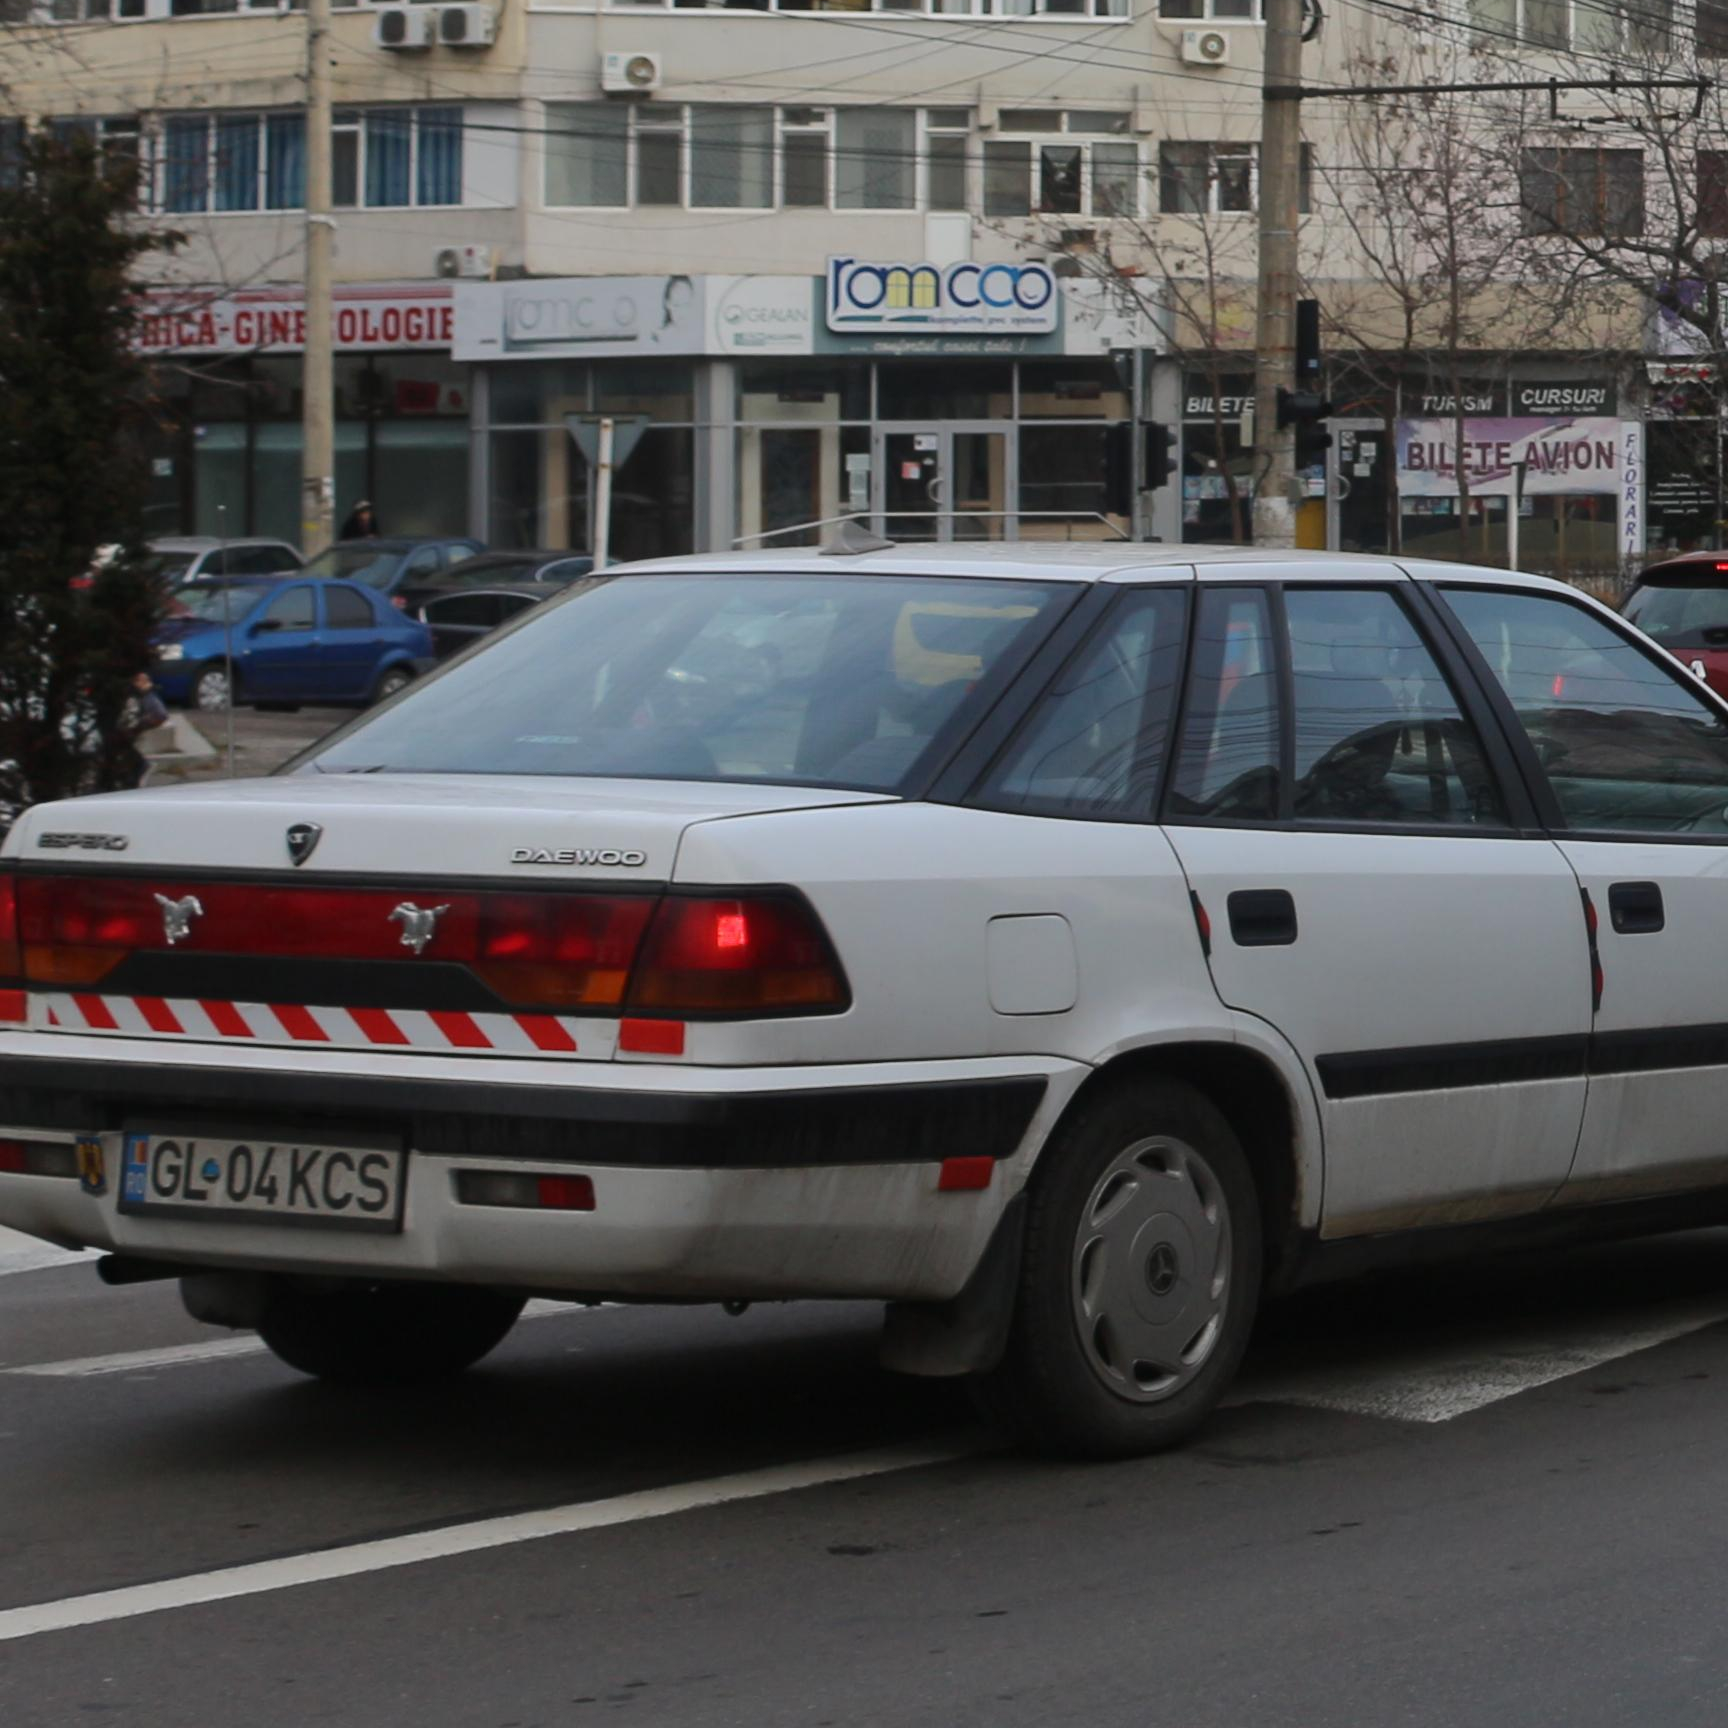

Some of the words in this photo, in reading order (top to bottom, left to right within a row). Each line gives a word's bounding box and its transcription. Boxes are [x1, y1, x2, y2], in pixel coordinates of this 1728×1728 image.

[1187, 396, 1255, 413] BILETE
[1520, 388, 1605, 404] CURSURI
[1407, 441, 1511, 471] BILETE
[1524, 441, 1615, 471] AVION
[510, 847, 647, 866] DAEWOO
